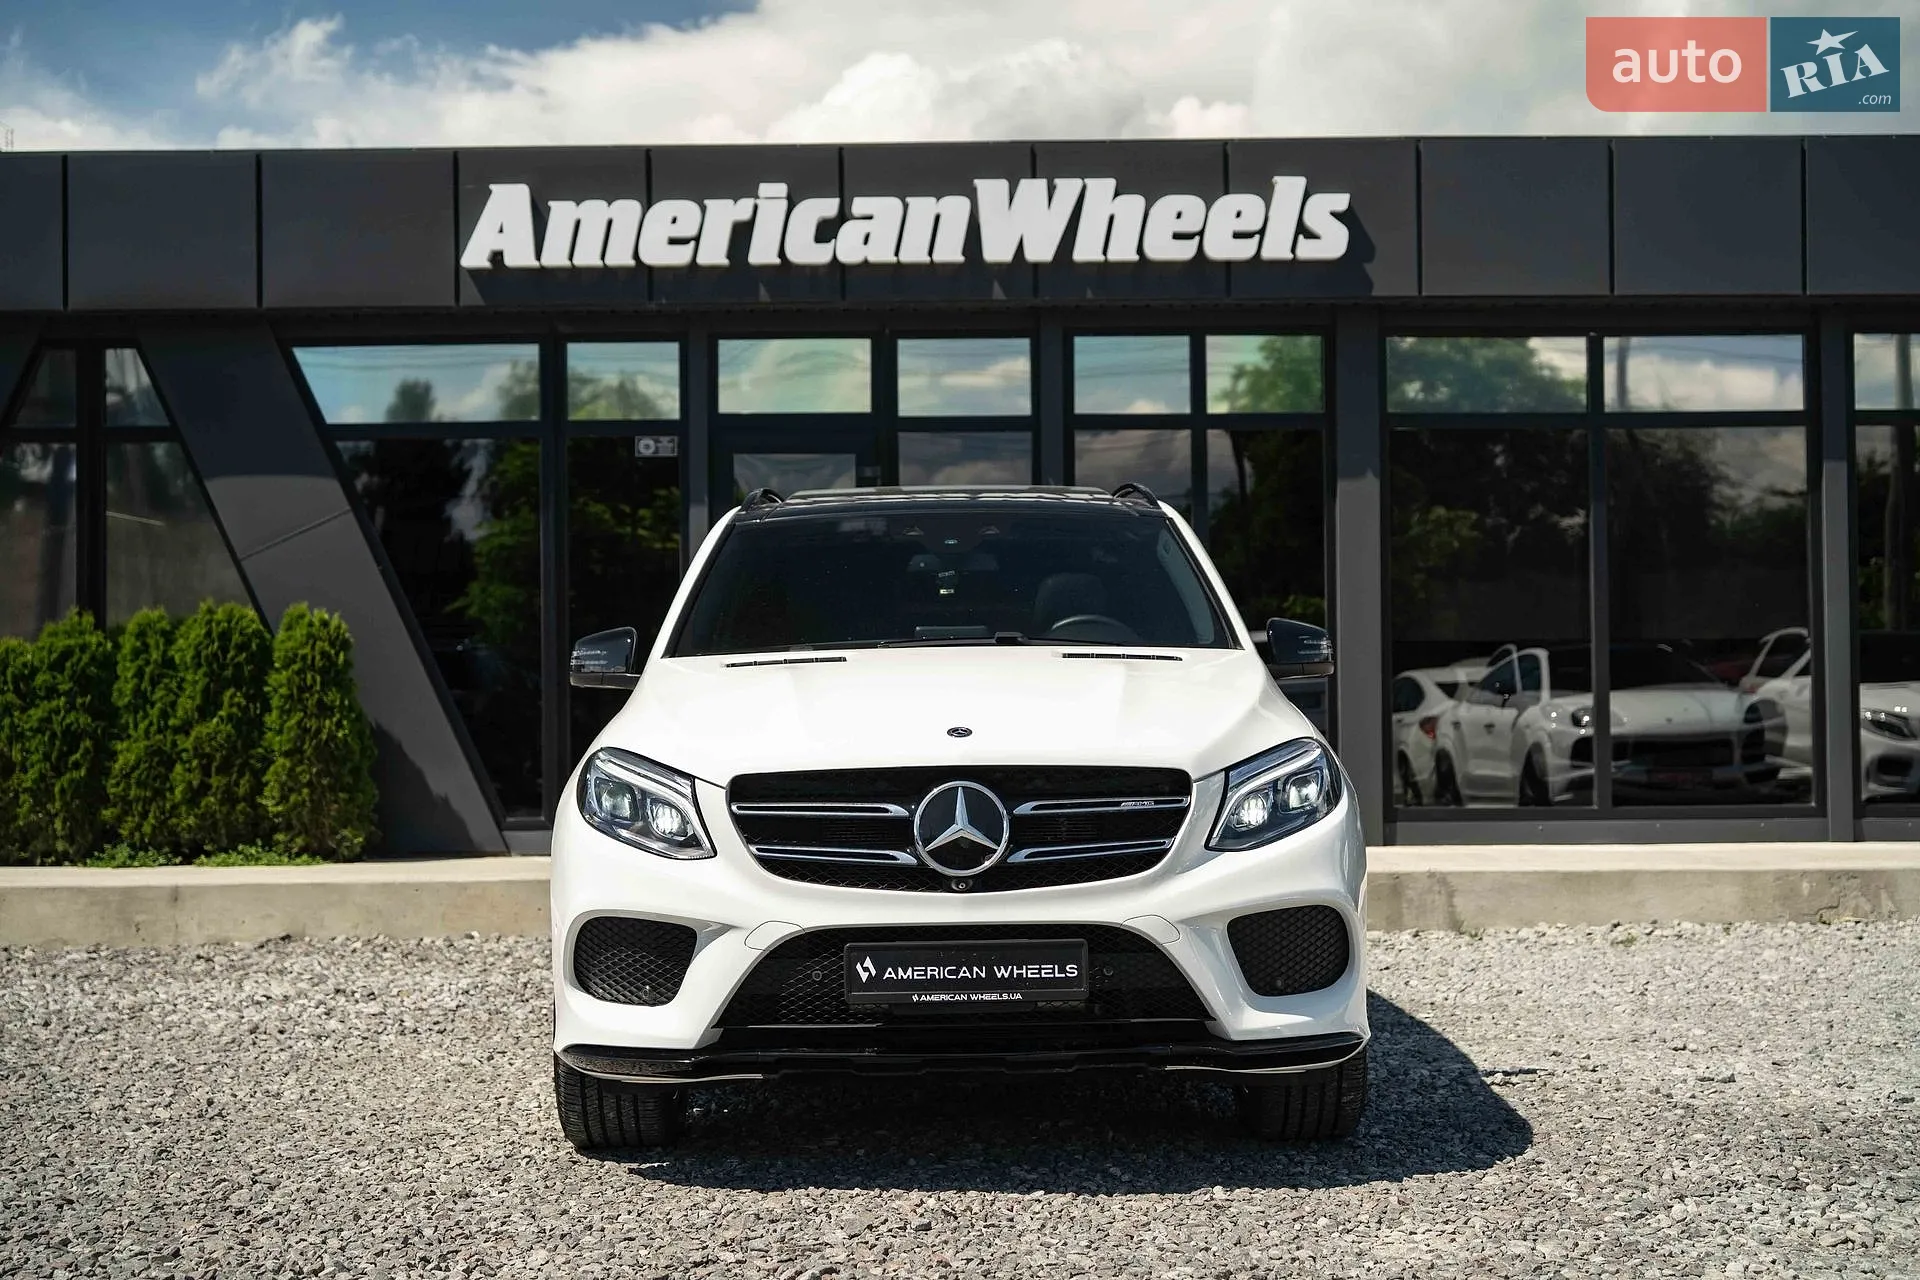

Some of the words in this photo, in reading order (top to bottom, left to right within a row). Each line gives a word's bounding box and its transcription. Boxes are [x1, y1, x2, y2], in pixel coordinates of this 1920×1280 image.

[883, 966, 986, 980] AMERICAN
[993, 964, 1079, 979] WHEELS
[919, 993, 968, 1002] AMERICAN
[969, 992, 1023, 1001] WHEELS.UA
